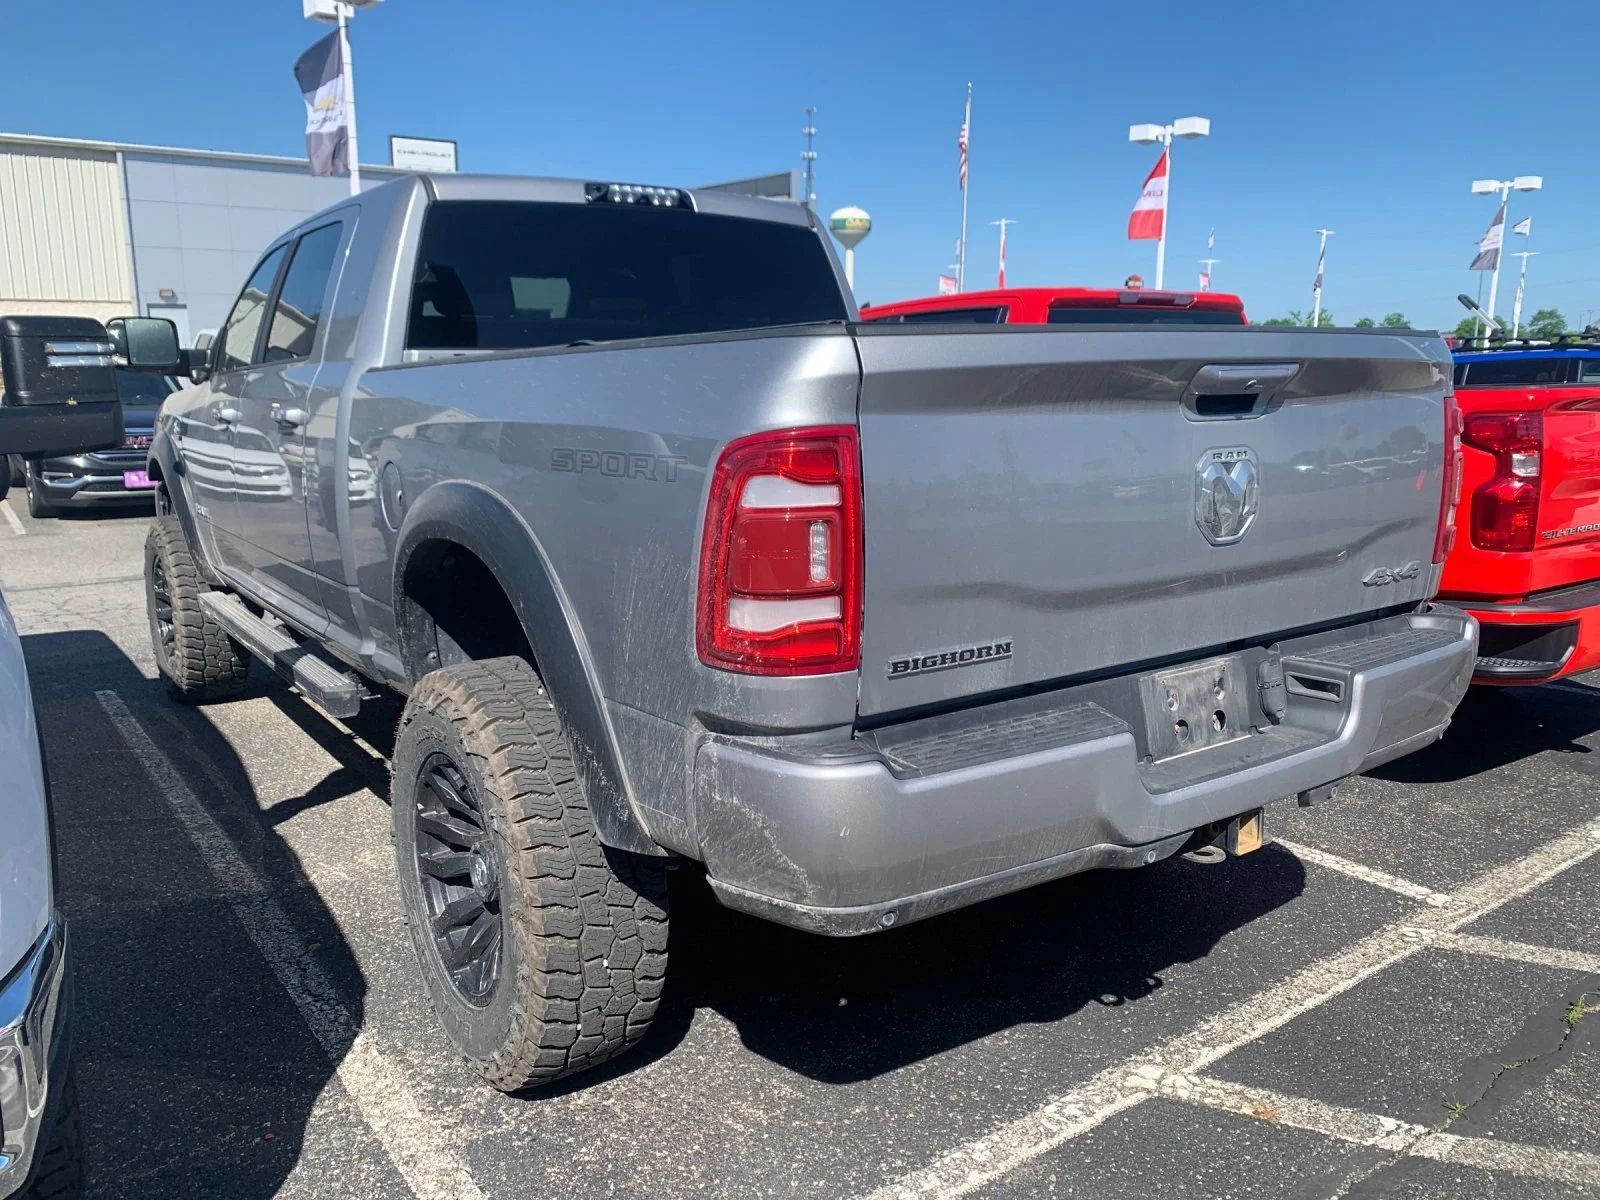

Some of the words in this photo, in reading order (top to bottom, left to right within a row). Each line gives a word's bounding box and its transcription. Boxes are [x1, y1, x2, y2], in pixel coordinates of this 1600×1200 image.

[550, 447, 687, 482] SPORT
[1213, 450, 1248, 460] RAM
[1542, 523, 1600, 539] SILVERAD
[888, 640, 1012, 679] BIGHORN
